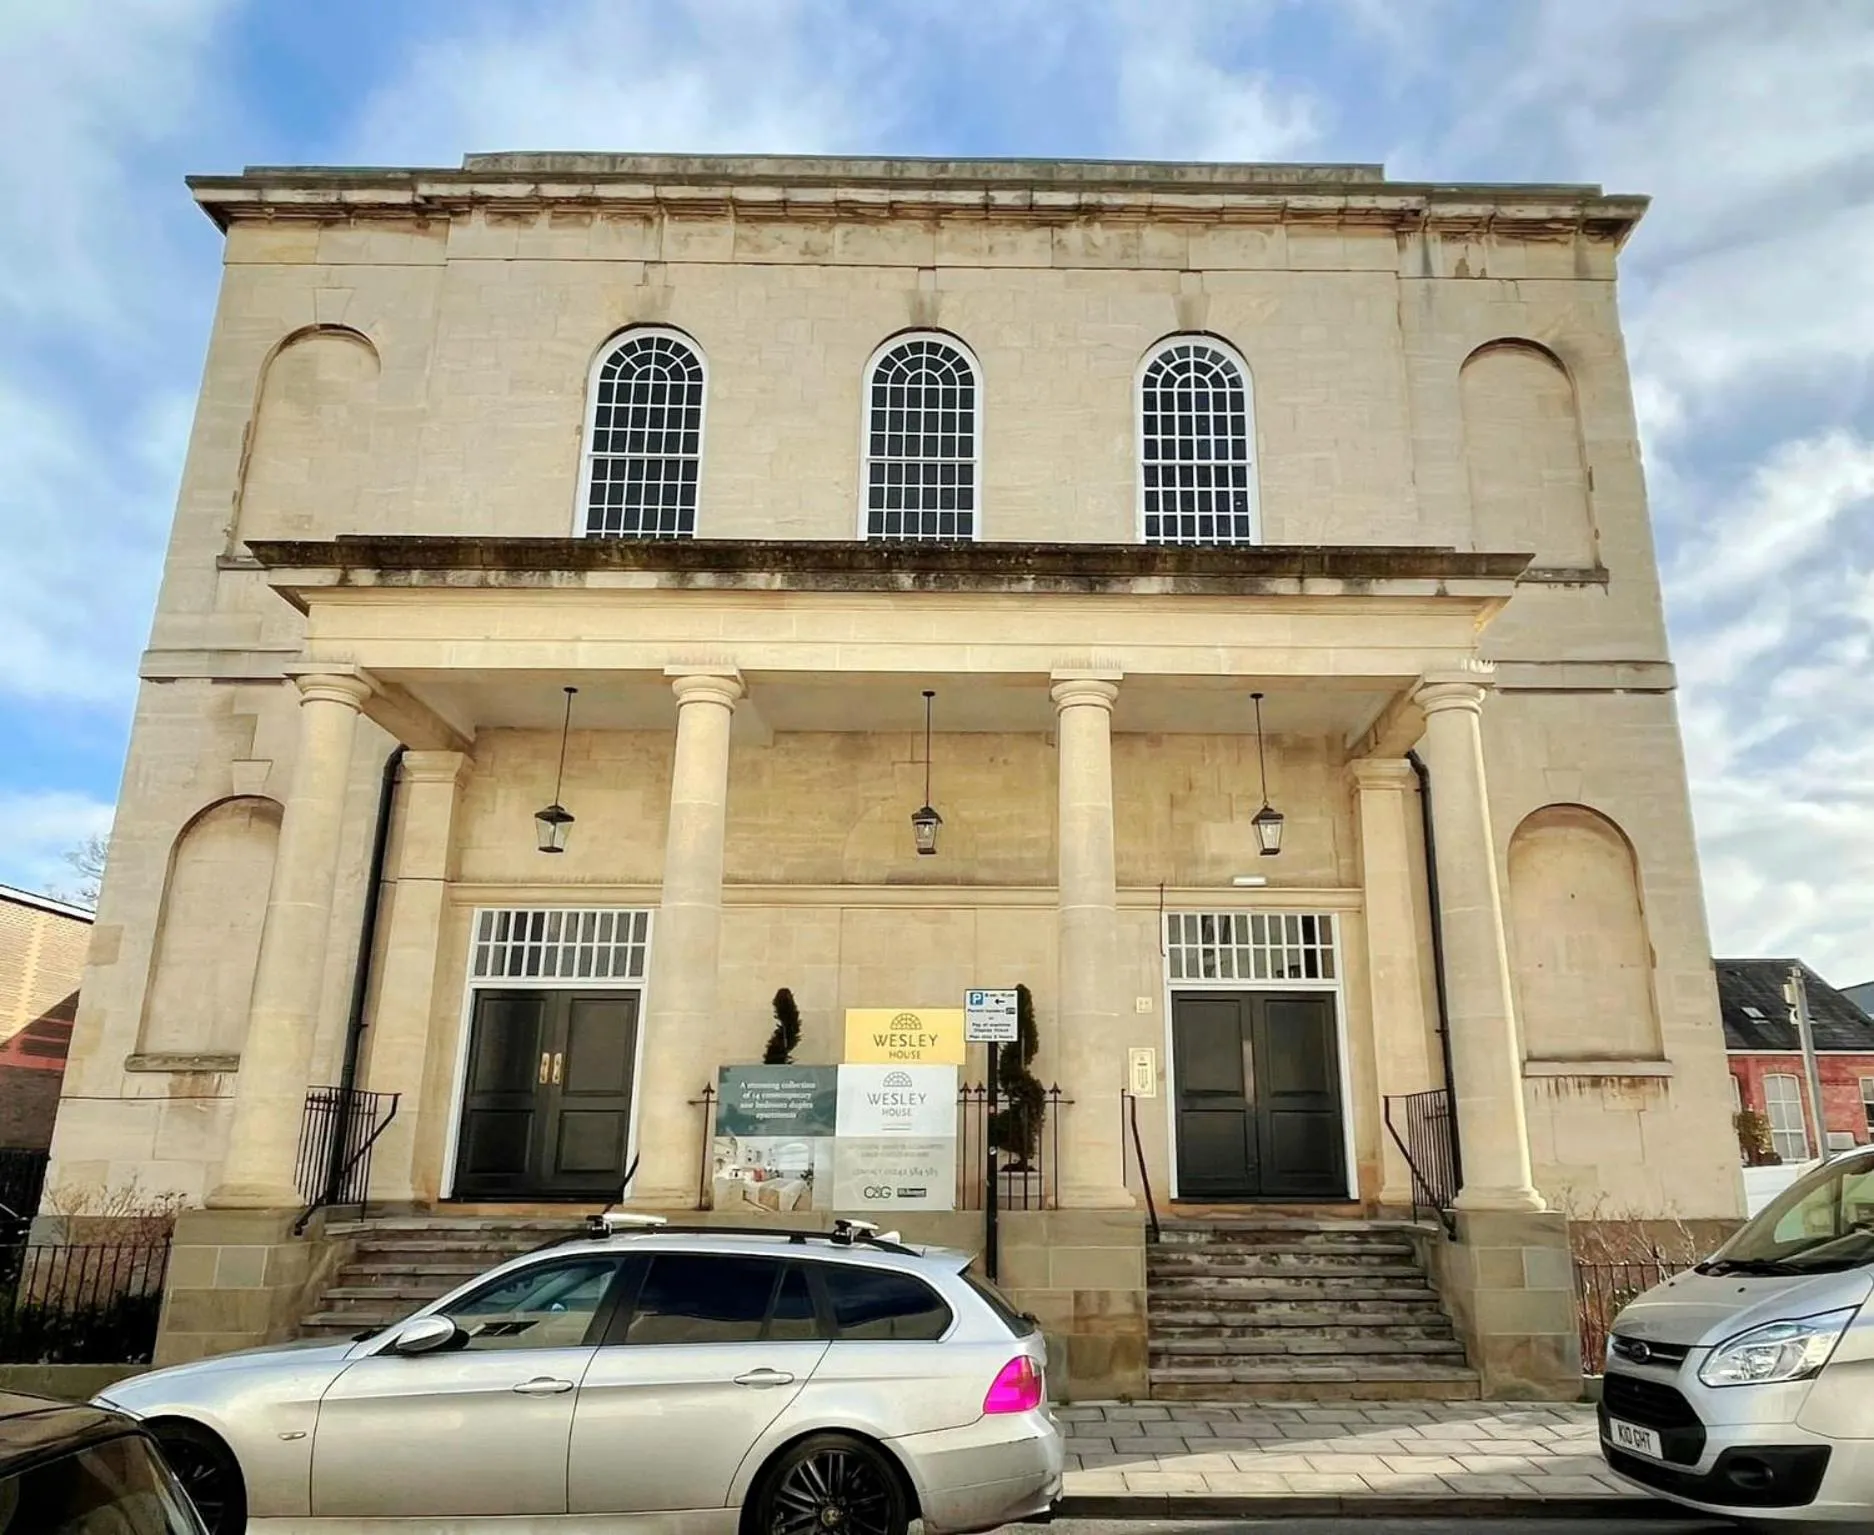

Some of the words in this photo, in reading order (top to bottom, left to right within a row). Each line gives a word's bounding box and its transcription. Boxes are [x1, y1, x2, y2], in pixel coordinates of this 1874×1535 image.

[873, 1034, 938, 1048] WESLEY
[888, 1050, 921, 1060] HOUSE
[867, 1092, 927, 1106] WESLEY
[882, 1107, 912, 1117] HOUSE
